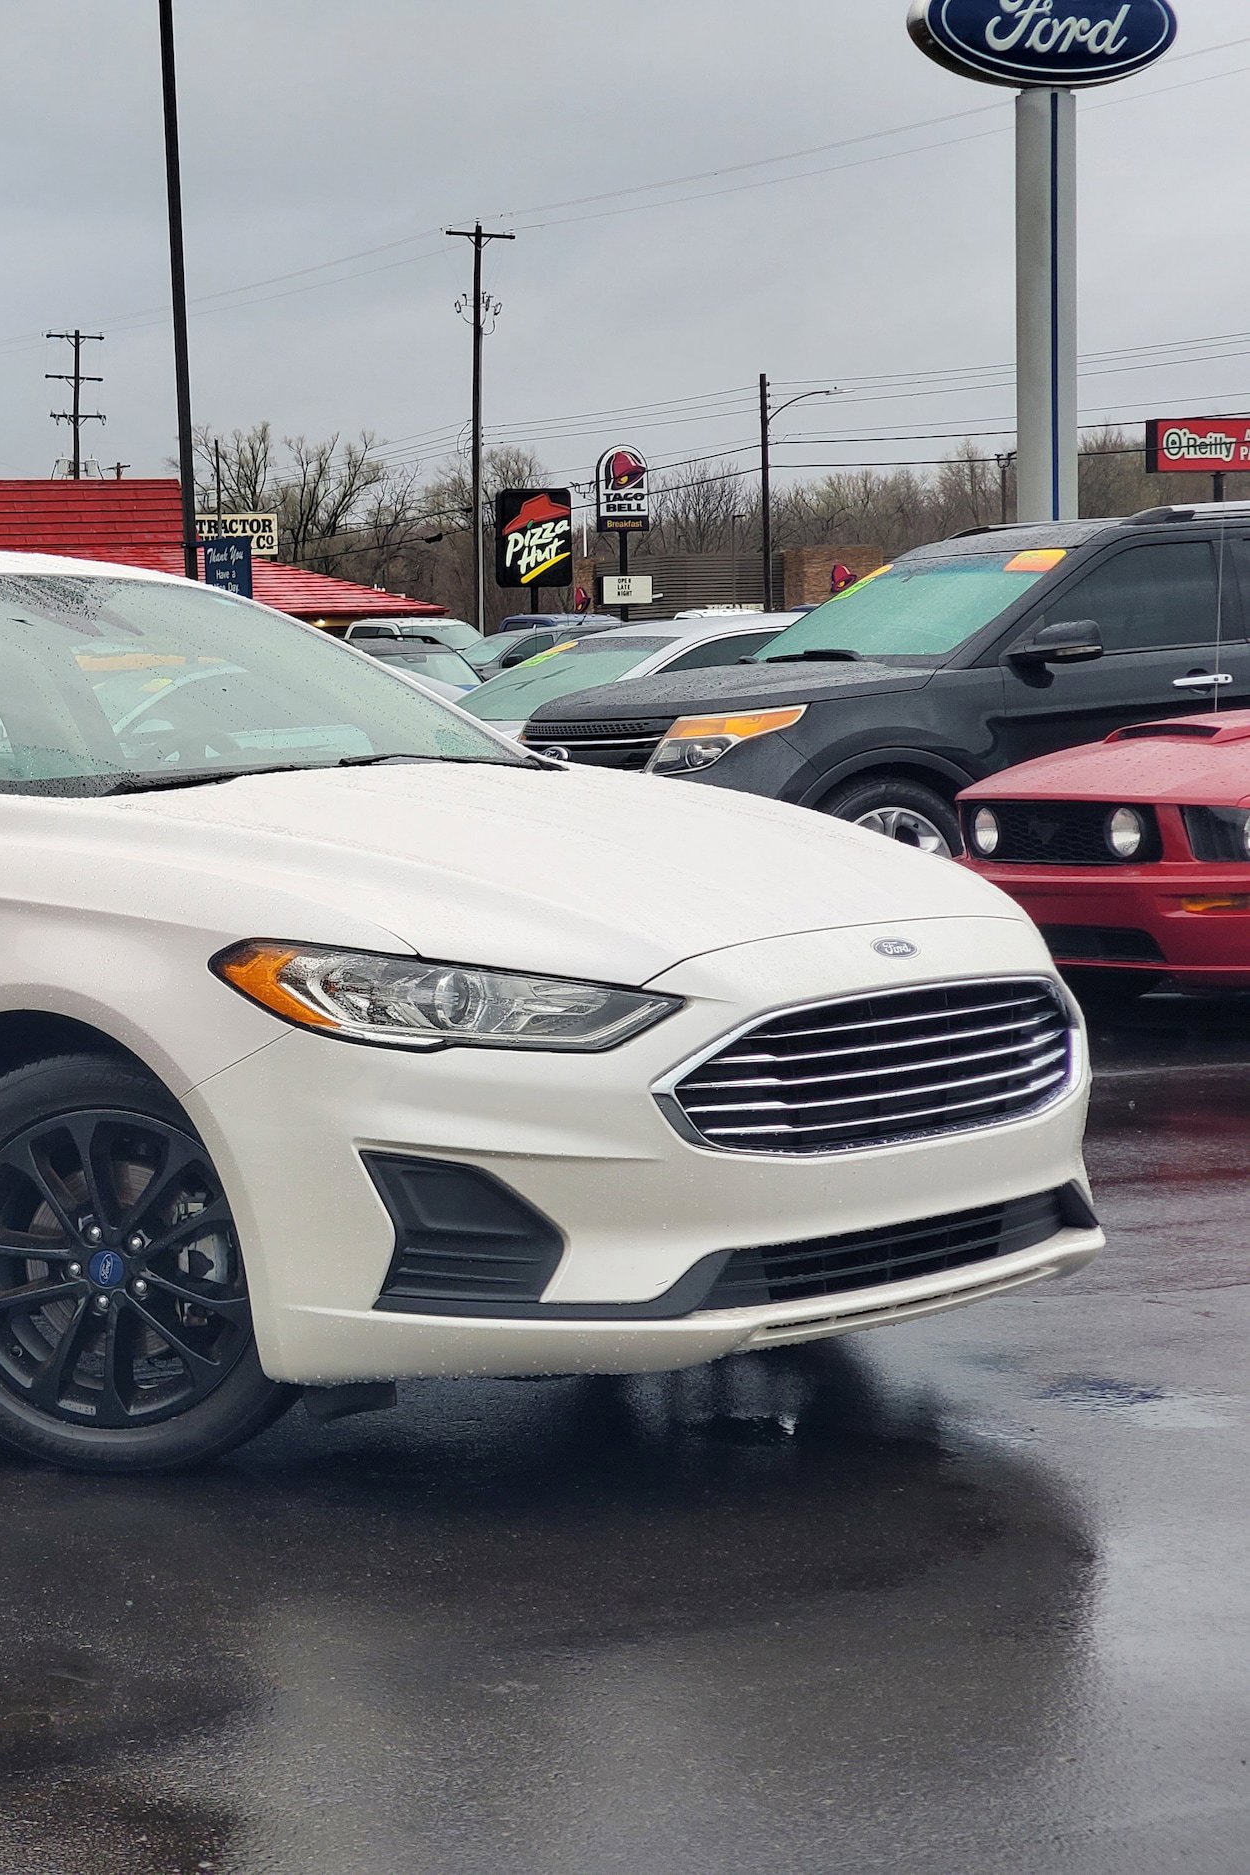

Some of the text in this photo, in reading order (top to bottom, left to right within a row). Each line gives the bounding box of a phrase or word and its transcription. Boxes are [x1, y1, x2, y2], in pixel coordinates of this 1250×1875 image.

[985, 0, 1132, 54] Ford
[1163, 429, 1237, 461] O'Reilly
[603, 493, 645, 501] TACO
[606, 503, 646, 512] BELL
[196, 519, 273, 534] TRACTOR
[607, 520, 643, 528] Breakfast
[506, 520, 570, 567] Pizza
[207, 545, 244, 565] Thank You
[517, 538, 565, 574] Hut
[216, 569, 237, 579] Have a
[882, 941, 911, 955] Ford
